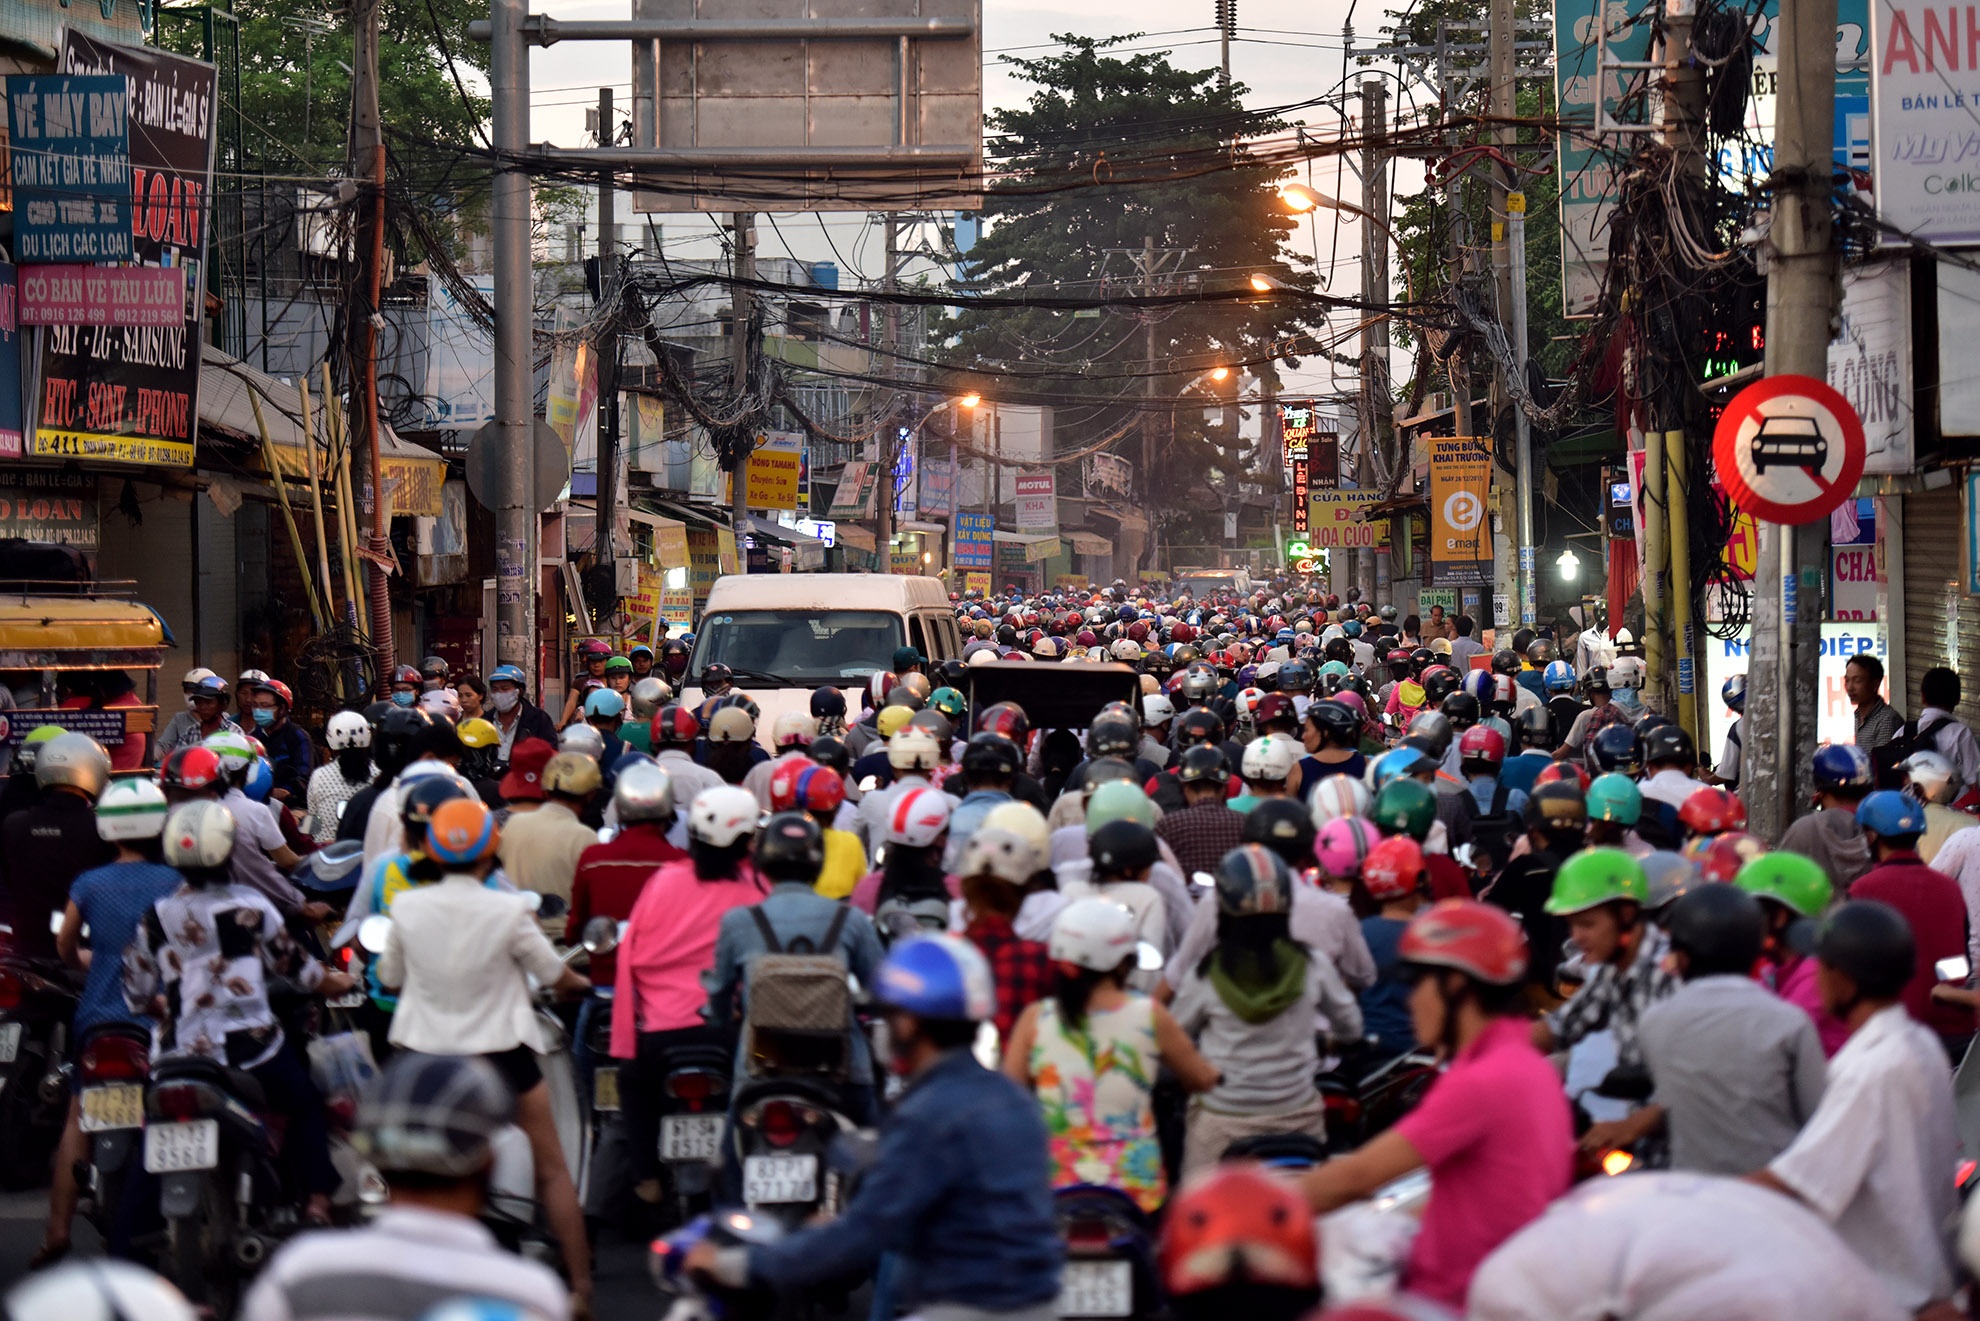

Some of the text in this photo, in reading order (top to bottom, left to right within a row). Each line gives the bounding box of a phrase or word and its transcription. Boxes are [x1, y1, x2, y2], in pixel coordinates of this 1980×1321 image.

[13, 81, 39, 138] VÉ
[44, 81, 84, 138] MÁY
[88, 92, 126, 137] BAY
[144, 70, 164, 129] BÁN
[199, 80, 210, 140] SỈ
[1902, 94, 1938, 111] BÁN
[1944, 89, 1964, 109] LẺ
[14, 141, 126, 186] CAM KẾT GIÁ RẺ NHẤT
[27, 194, 118, 225] CHO THUÊ XE
[132, 167, 202, 249] LOAN
[22, 228, 128, 260] DU LỊCH CÁC LOẠI
[24, 272, 177, 305] CÓ BÁN VÉ TÀU LỬA
[40, 307, 64, 322] 0916
[68, 308, 85, 322] 126
[88, 309, 105, 323] 499
[114, 309, 137, 323] 0912
[141, 310, 158, 324] 219
[161, 310, 178, 325] 564
[91, 325, 112, 361] LG
[122, 326, 187, 371] SAMSUNG
[43, 377, 189, 439] HTC SONY IPHONE
[51, 435, 79, 455] 411
[772, 459, 796, 470] YAMAHA
[1433, 452, 1490, 463] KHAI TRƯƠNG
[1018, 481, 1051, 490] MOTUL
[1313, 490, 1385, 502] CỬA HÀNG
[17, 498, 82, 521] LOAN
[1025, 502, 1045, 511] KHA
[960, 515, 991, 529] VẬT LIỆU
[957, 528, 992, 542] XÂY DỰNG
[1312, 527, 1339, 547] HOA
